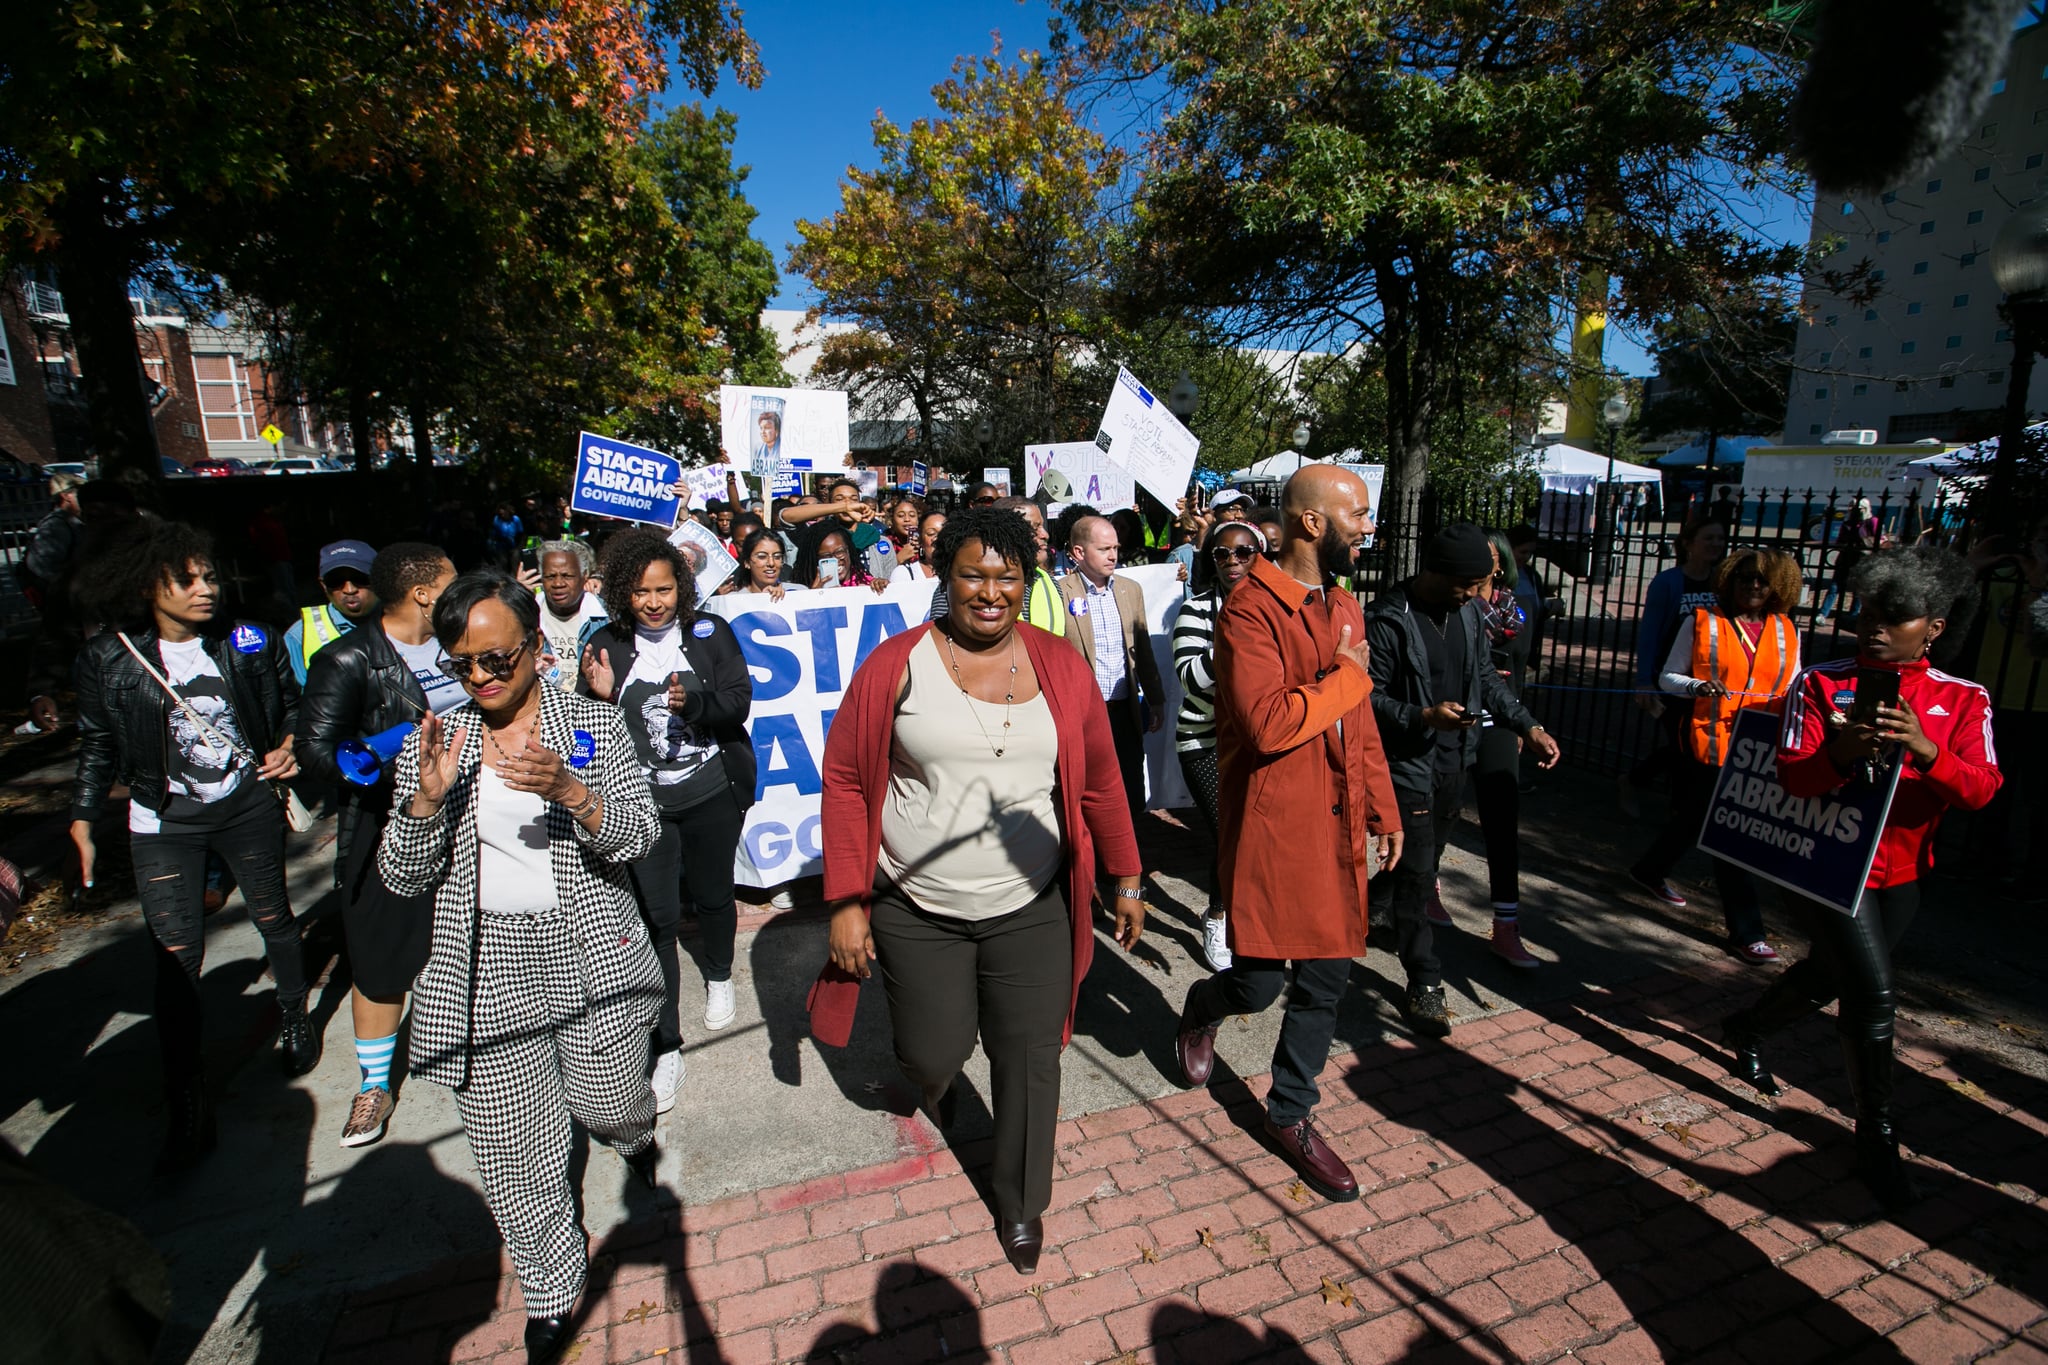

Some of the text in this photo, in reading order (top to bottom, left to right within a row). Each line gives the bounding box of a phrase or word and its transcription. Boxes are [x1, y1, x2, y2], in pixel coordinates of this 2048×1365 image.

[752, 400, 765, 410] BE
[586, 445, 668, 481] STACEY
[1358, 470, 1382, 481] VOZ
[1833, 455, 1891, 466] STE(A)M
[1833, 467, 1884, 478] TRUCK
[581, 487, 653, 511] GOVERNOR
[582, 466, 676, 501] ABRAMS
[681, 524, 733, 573] BE HEARD
[729, 602, 910, 701] STA
[1732, 737, 1778, 778] STA
[1720, 772, 1863, 844] ABRAMS
[1714, 806, 1816, 860] GOVERNOR
